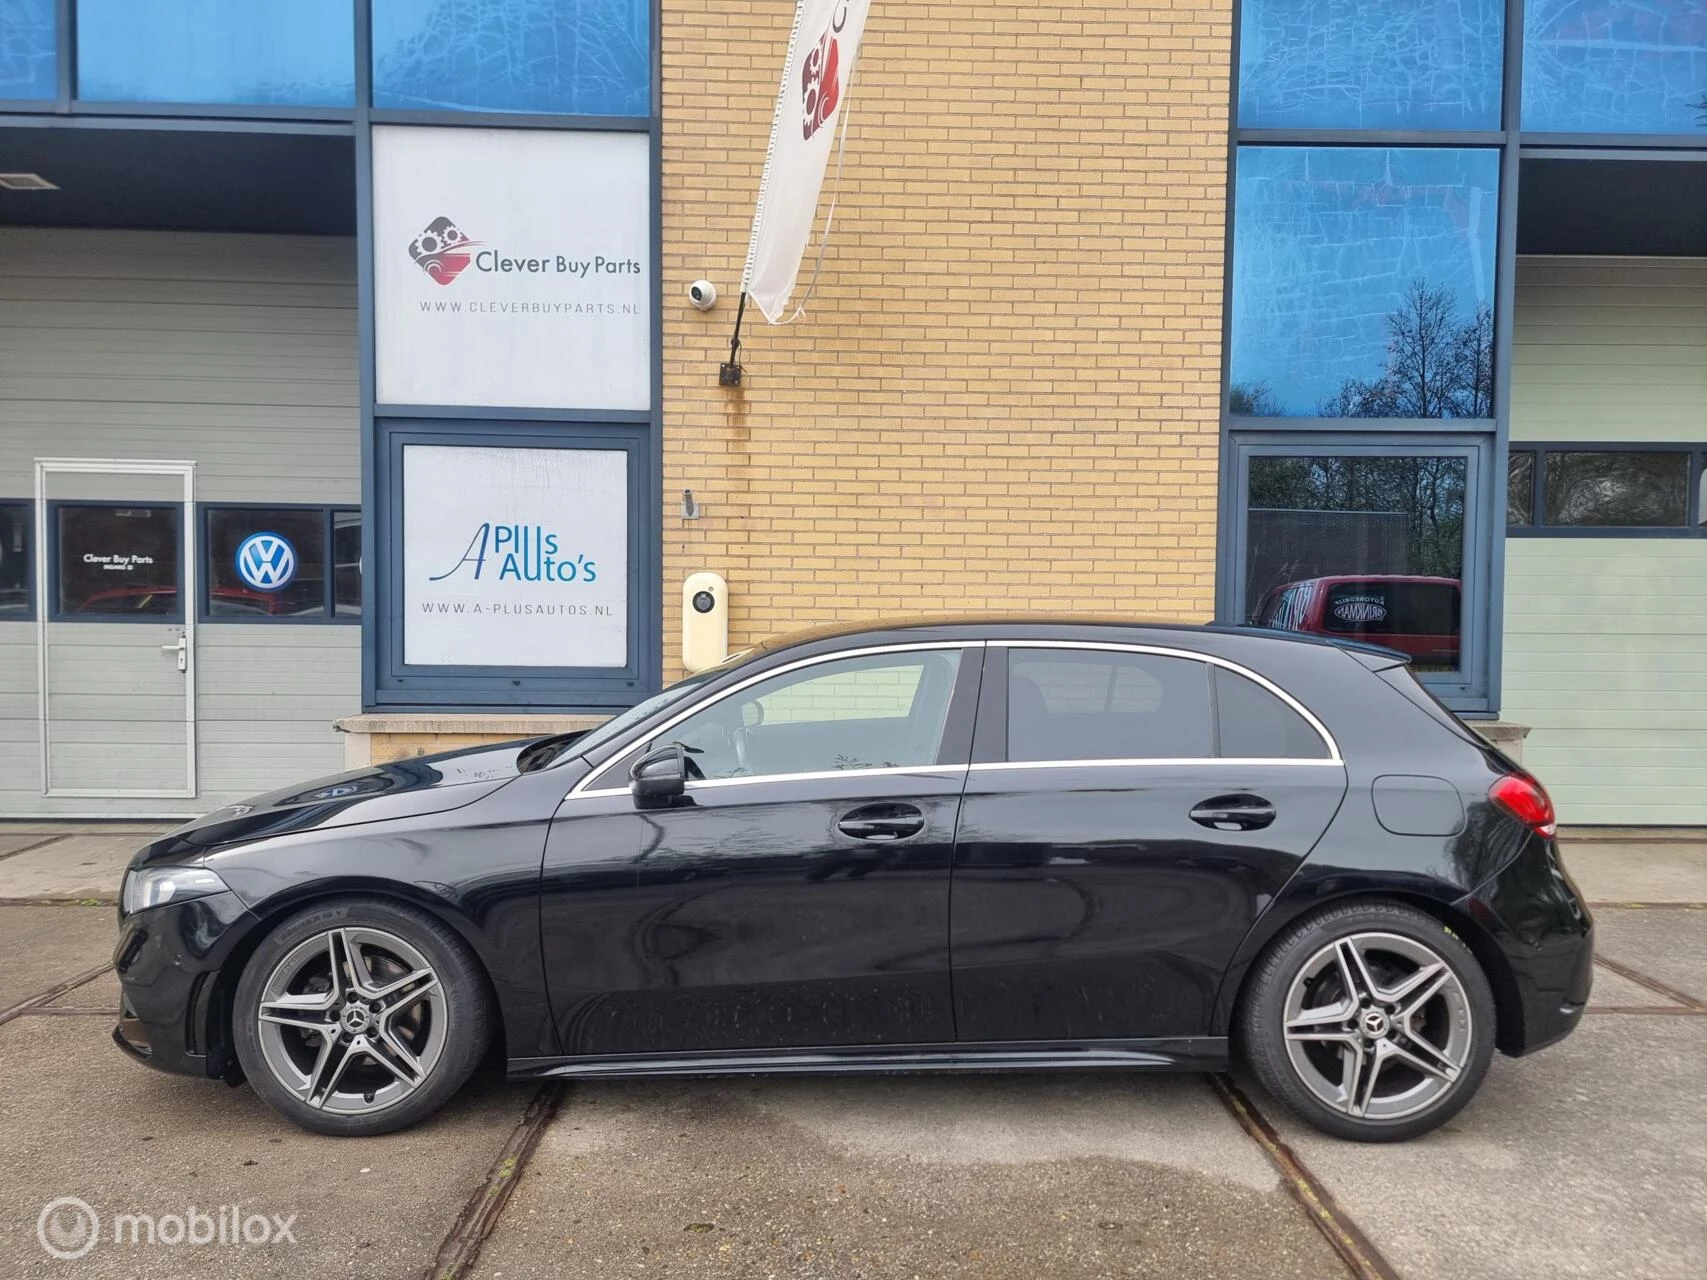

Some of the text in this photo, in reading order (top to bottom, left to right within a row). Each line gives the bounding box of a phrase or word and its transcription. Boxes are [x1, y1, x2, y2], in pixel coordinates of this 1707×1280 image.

[475, 250, 641, 278] Clever Buy Parts
[419, 300, 640, 315] WWW.CLEVERBUYPARTS.NL
[113, 554, 130, 565] Buy
[131, 554, 154, 564] Parts
[422, 602, 613, 616] WWW.A-PLUSAUTOS.NL
